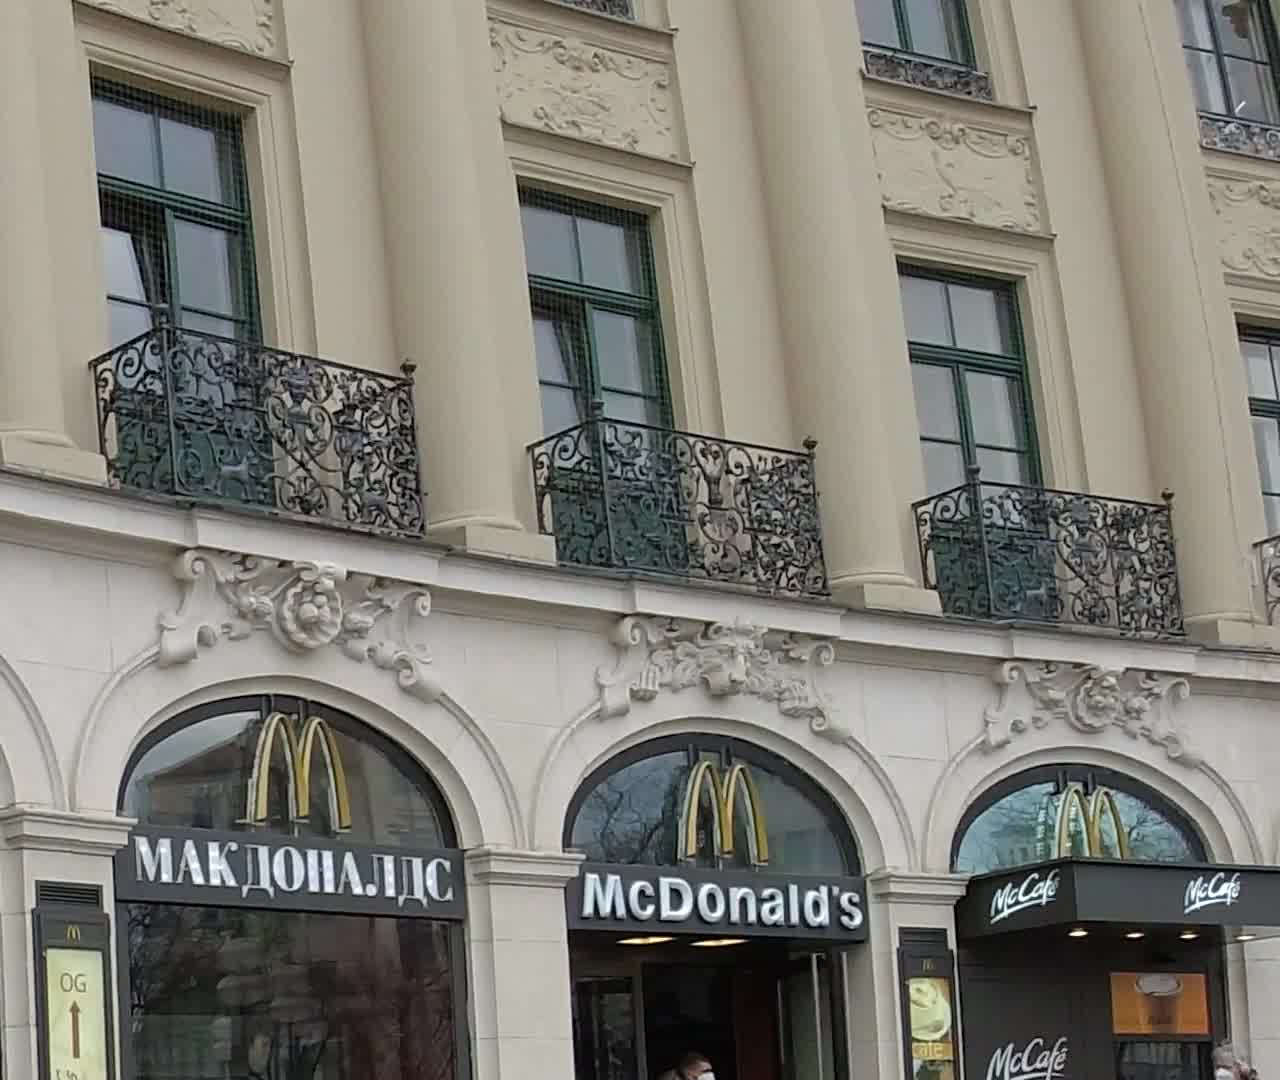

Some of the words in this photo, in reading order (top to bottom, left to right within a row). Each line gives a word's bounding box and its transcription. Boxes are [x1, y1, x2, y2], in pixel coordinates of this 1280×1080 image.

[134, 836, 454, 908] МАКДОНАЛДС
[990, 869, 1061, 924] McCafé
[1184, 872, 1241, 914] McCafé
[582, 872, 864, 931] McDonald's
[59, 972, 87, 994] OG
